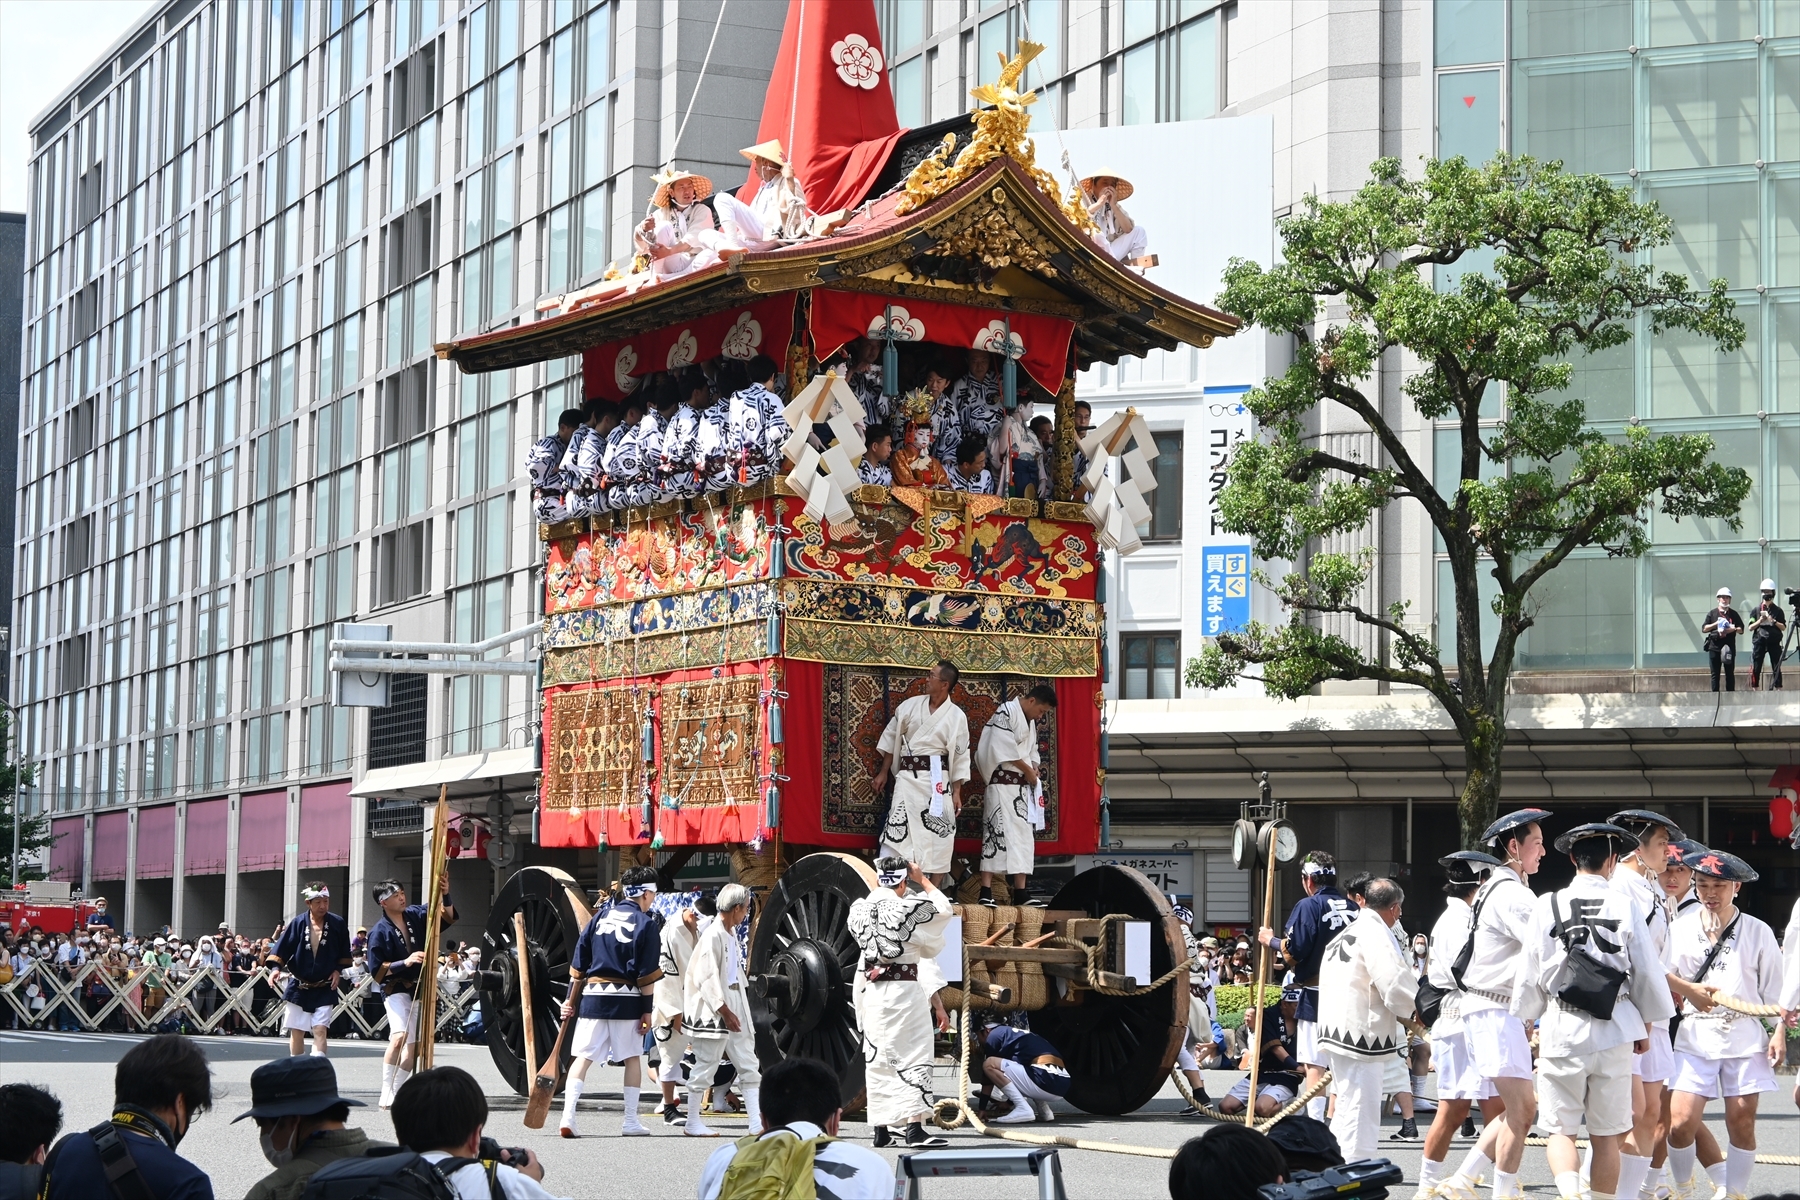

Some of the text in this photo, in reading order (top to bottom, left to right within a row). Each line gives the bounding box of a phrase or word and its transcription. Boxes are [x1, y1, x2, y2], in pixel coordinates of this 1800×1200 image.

[1227, 554, 1245, 597] すぐ
[1206, 554, 1224, 634] 買えます
[1120, 860, 1179, 869] メガネスーパー
[111, 1112, 135, 1123] Niko
